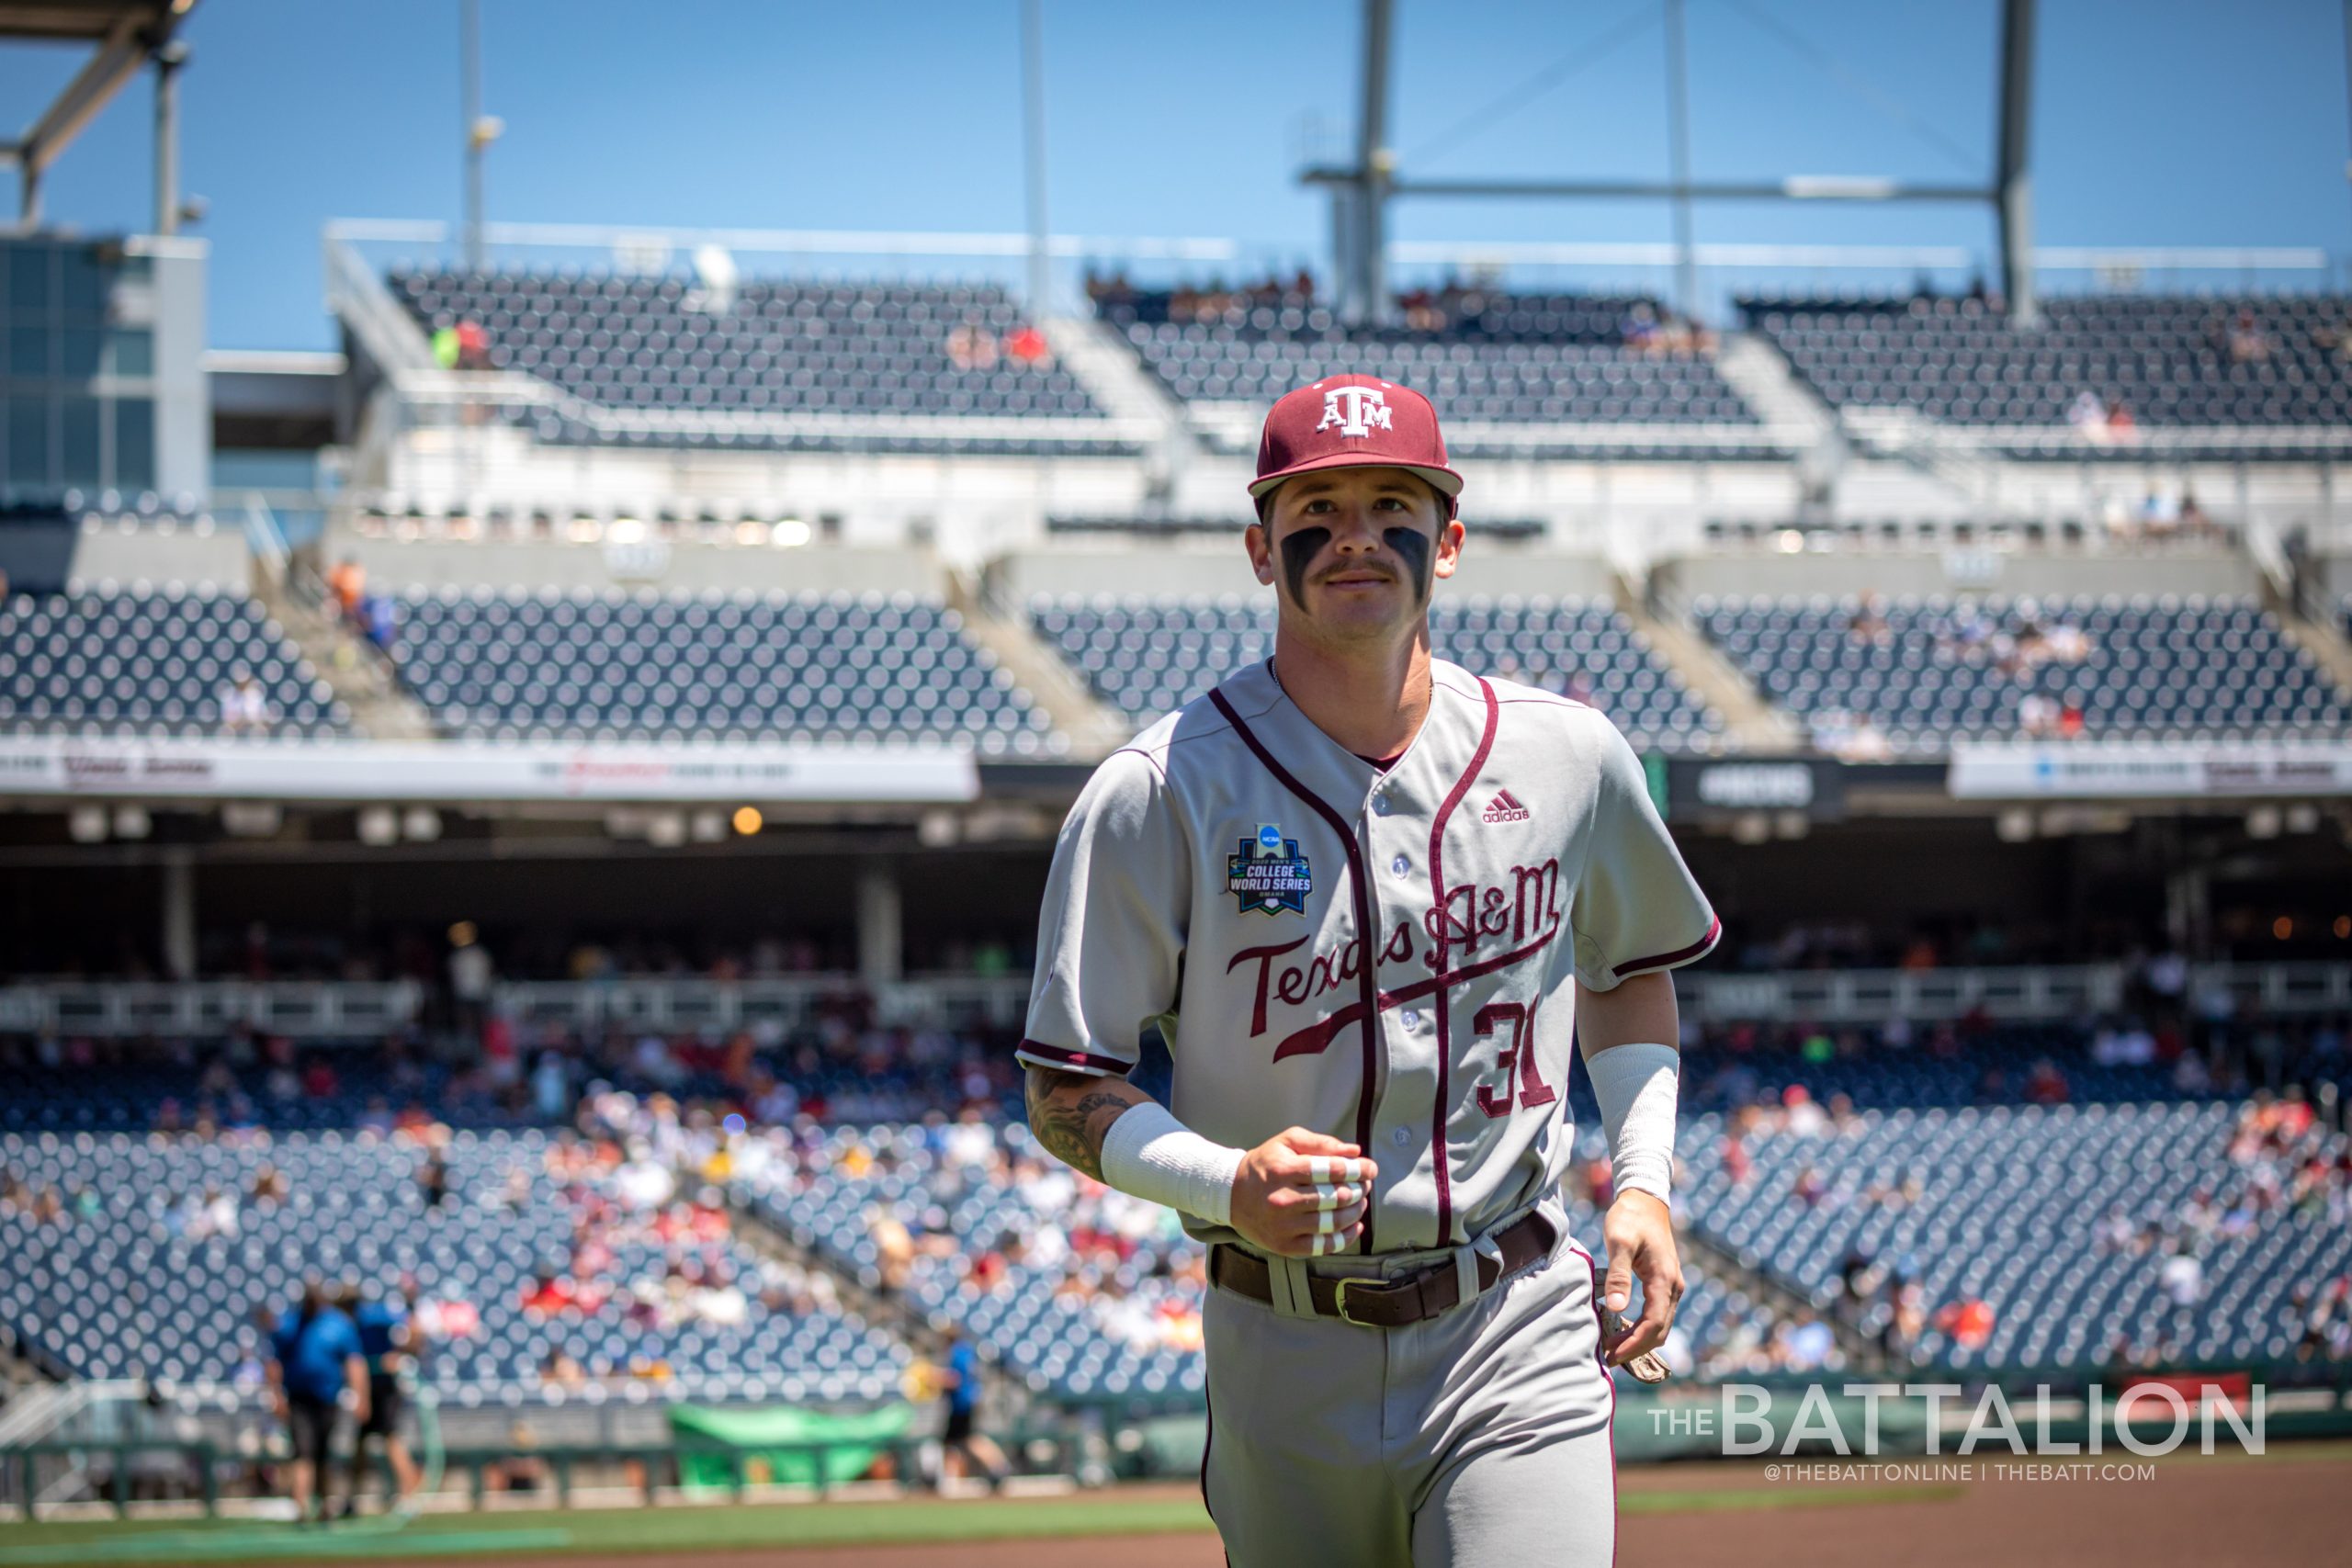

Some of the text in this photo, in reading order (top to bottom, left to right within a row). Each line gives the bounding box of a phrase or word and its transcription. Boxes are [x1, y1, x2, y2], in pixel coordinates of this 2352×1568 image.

[1482, 808, 1530, 823] adidas
[1247, 865, 1295, 877] COLLEGE
[1230, 878, 1311, 891] WORLD SERIES
[1227, 857, 1561, 1038] Texas A&M
[1473, 994, 1556, 1119] 31
